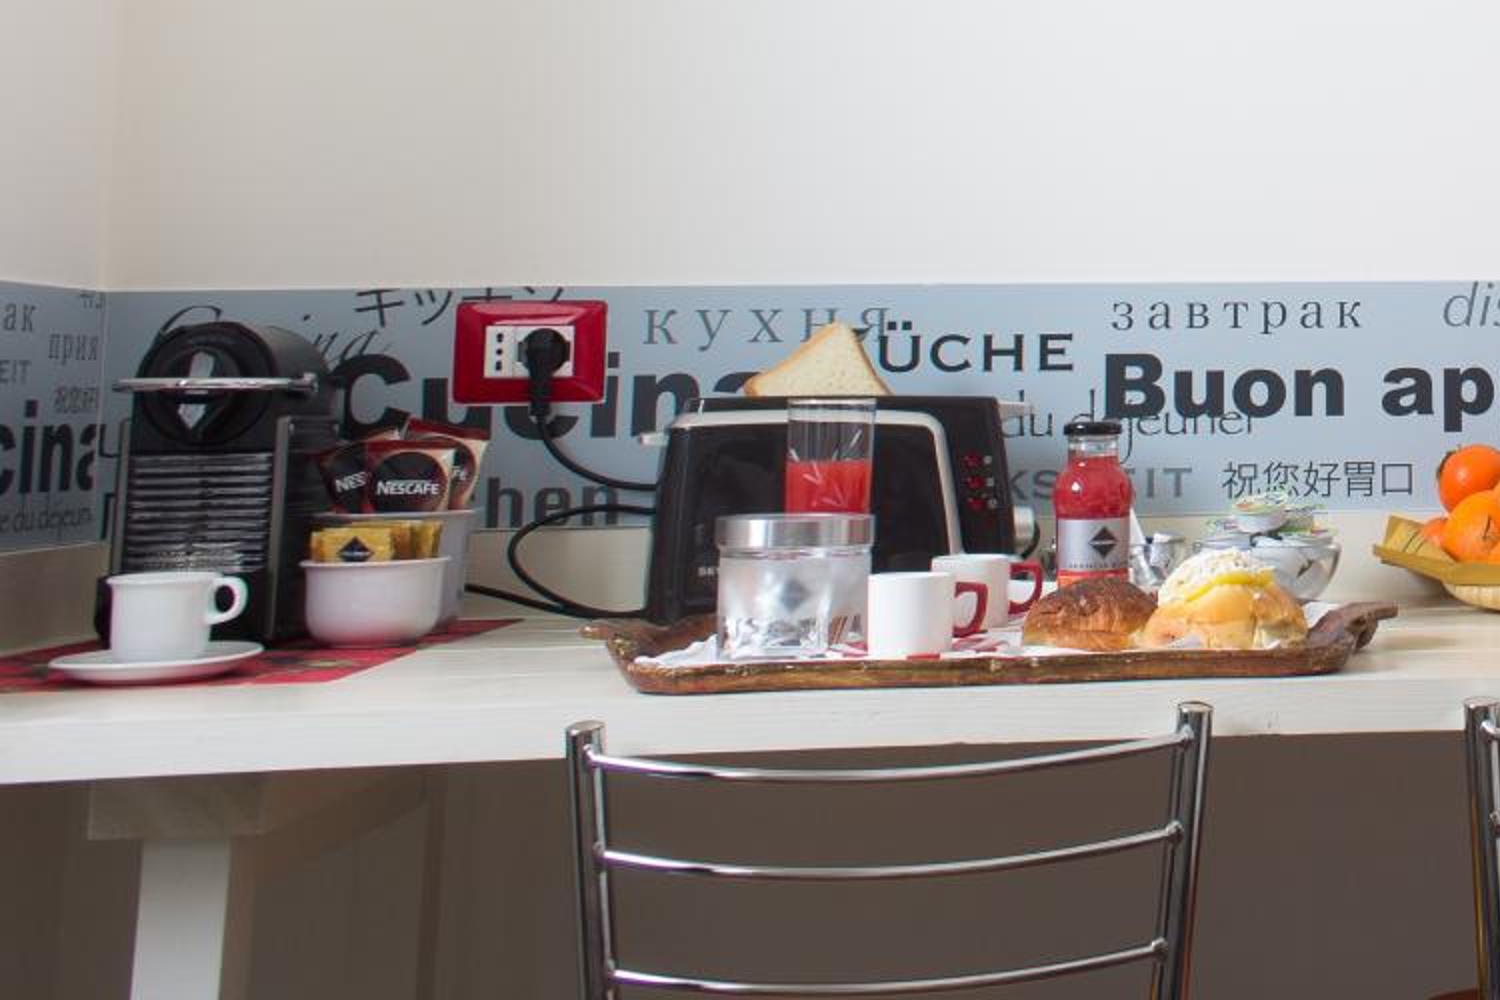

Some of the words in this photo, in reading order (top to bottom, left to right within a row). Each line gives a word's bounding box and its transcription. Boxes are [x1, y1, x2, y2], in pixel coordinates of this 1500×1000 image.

[1111, 300, 1362, 334] завтрак
[851, 320, 1074, 373] ÜCHE
[1105, 353, 1345, 418] Buon
